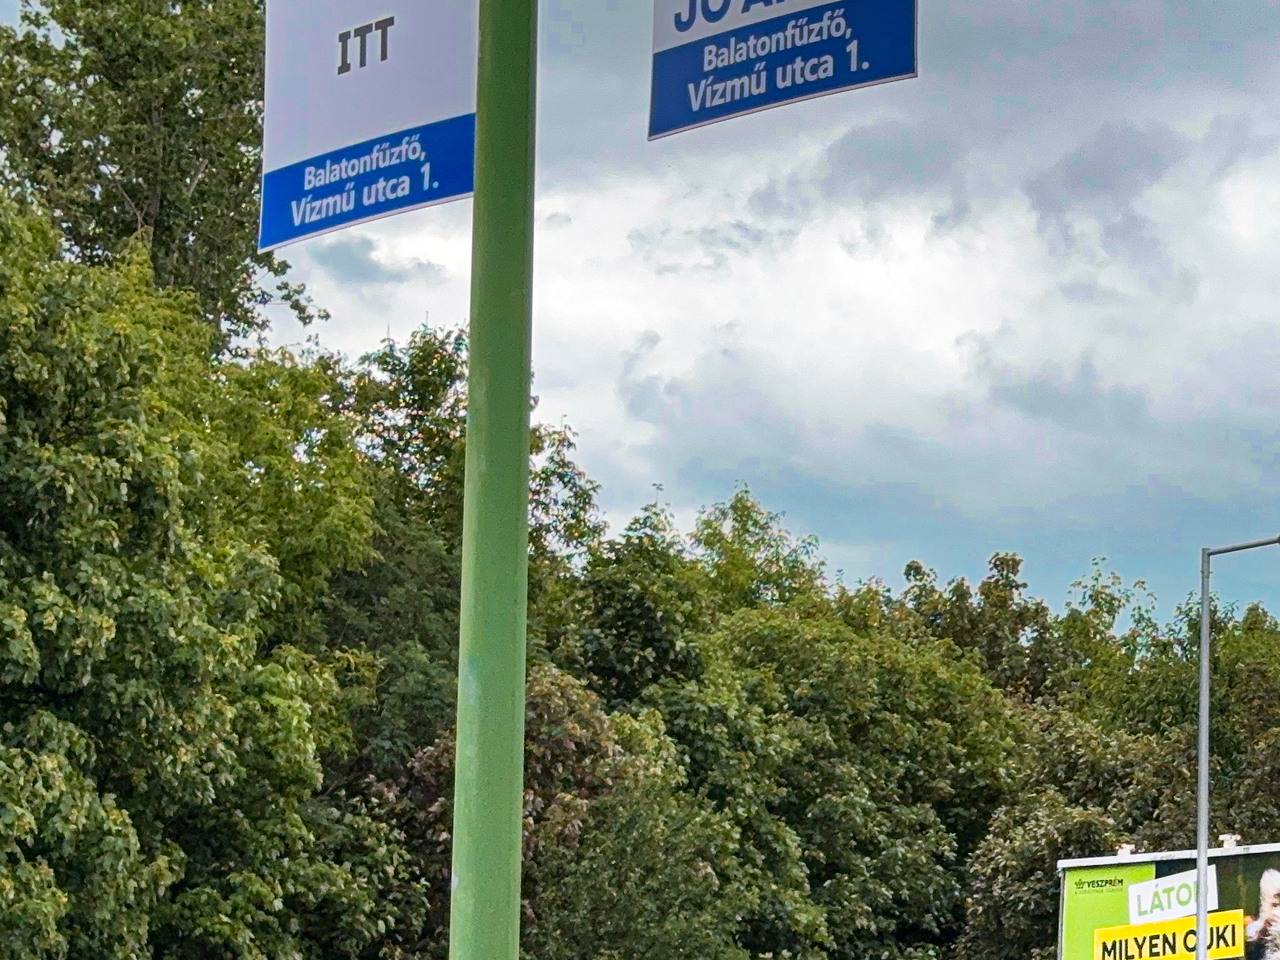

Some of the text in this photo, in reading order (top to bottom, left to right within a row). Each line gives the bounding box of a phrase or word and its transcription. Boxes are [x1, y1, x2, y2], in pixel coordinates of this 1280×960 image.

[337, 16, 395, 75] ITT
[703, 8, 852, 72] Balatonfűzfő,
[688, 40, 869, 111] Vízmű utca 1.
[291, 162, 439, 226] Vízmű utca 1.
[304, 134, 426, 190] Balatonfűzfő,
